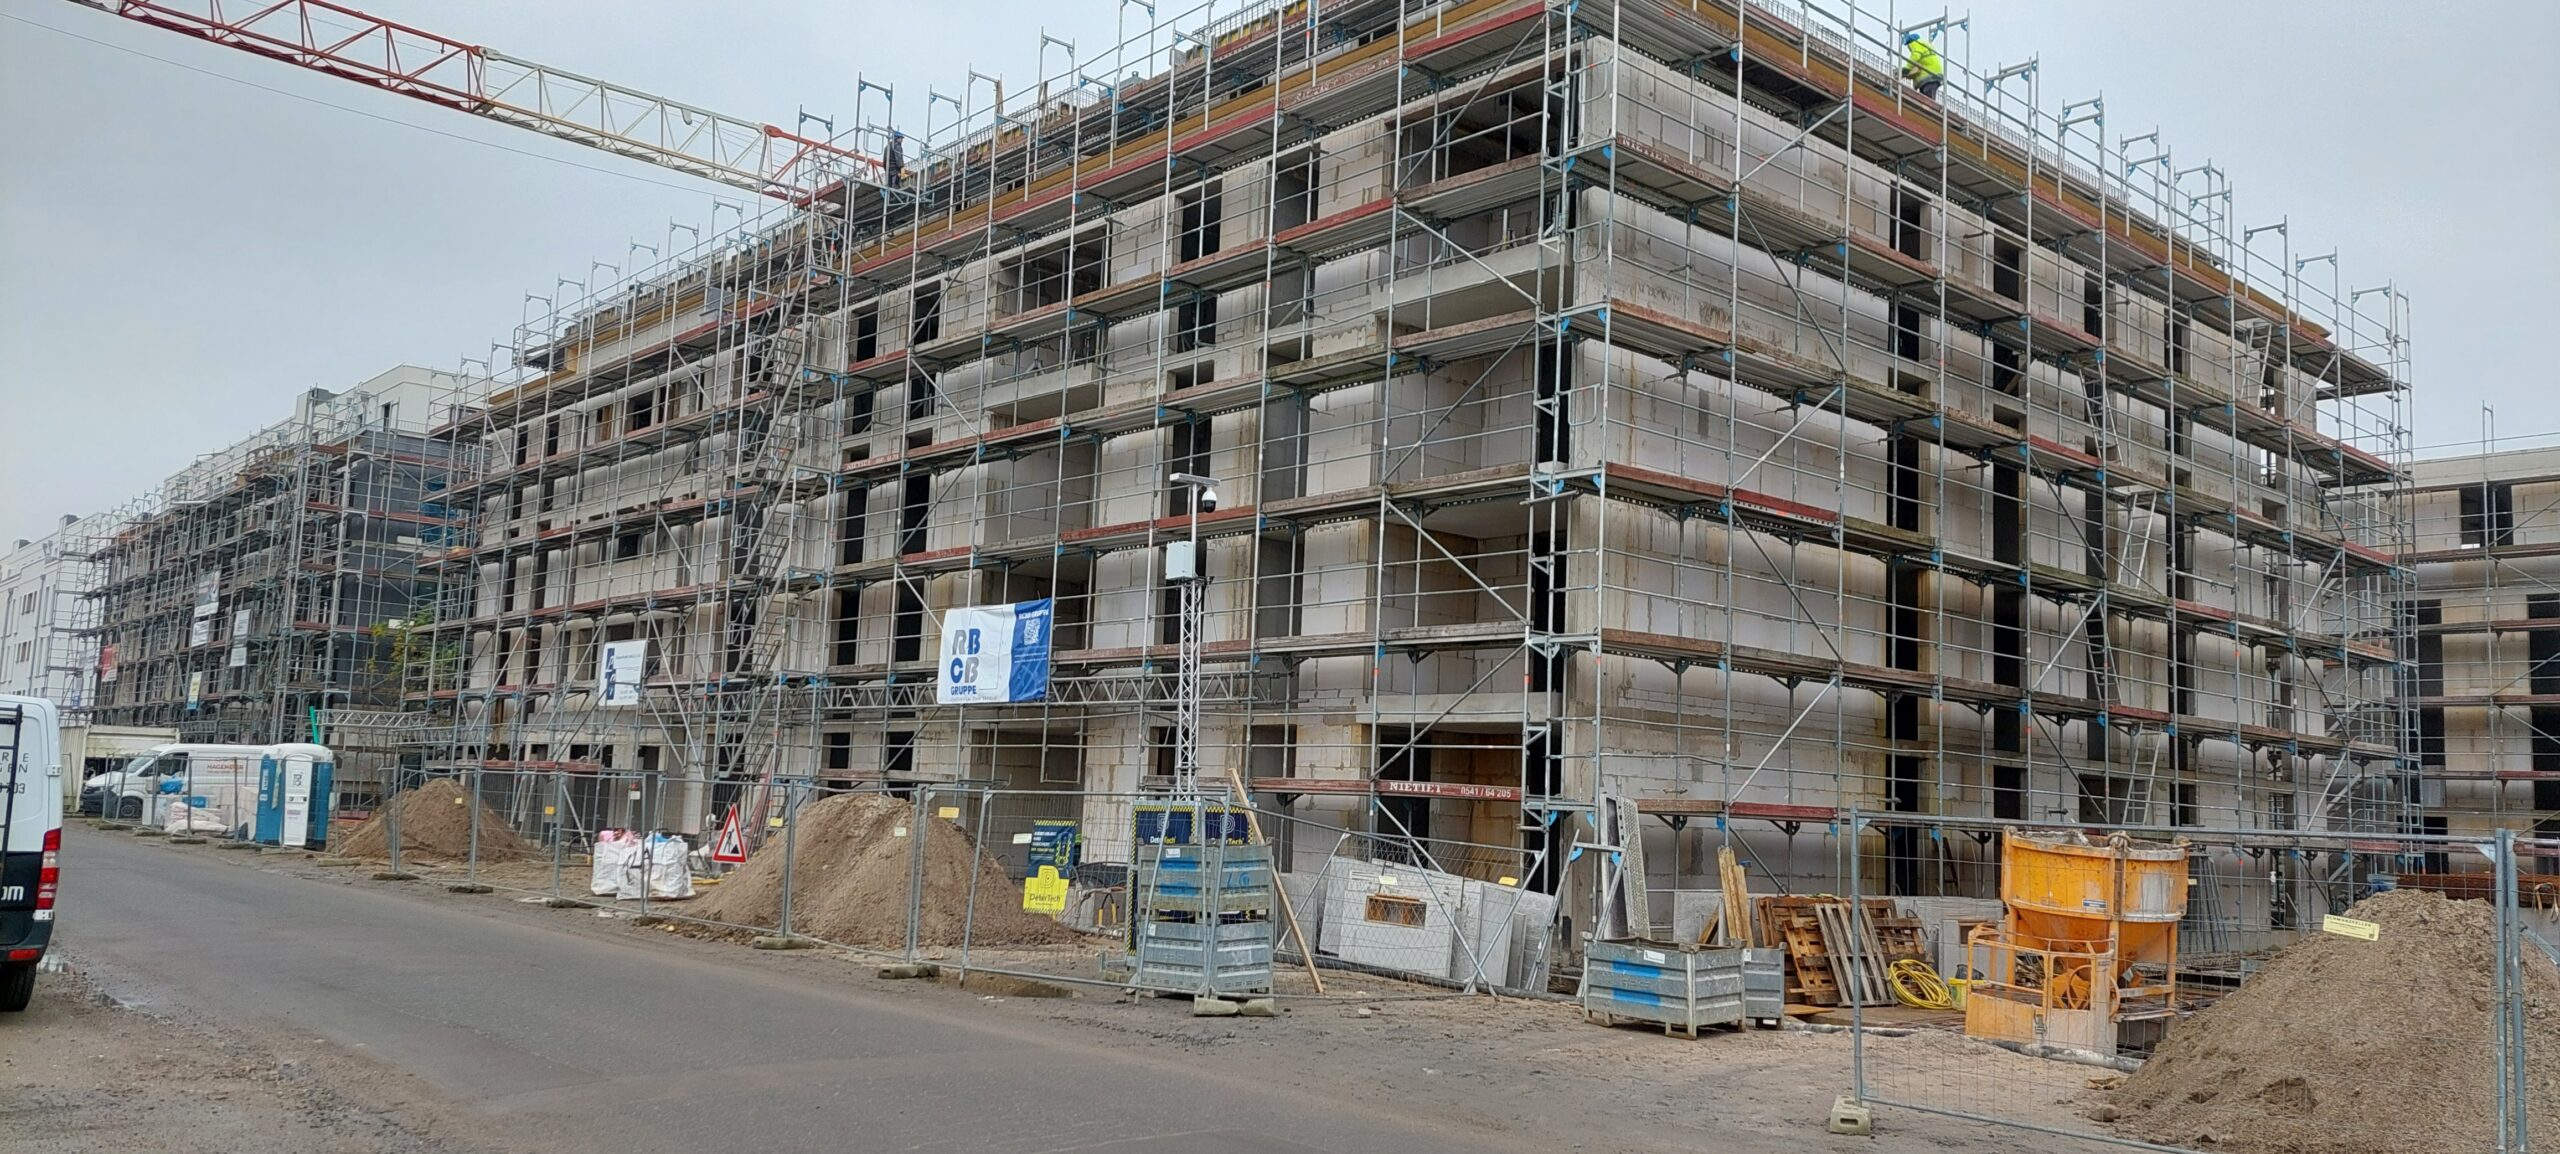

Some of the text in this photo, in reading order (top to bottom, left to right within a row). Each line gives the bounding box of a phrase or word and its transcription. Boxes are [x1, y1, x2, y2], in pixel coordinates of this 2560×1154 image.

[952, 628, 981, 655] RB
[950, 657, 979, 684] CB
[951, 685, 977, 696] GRUPPE
[1460, 786, 1479, 796] 0541
[1485, 788, 1495, 797] 64
[1497, 789, 1512, 798] 205
[1029, 893, 1061, 902] DeterTech
